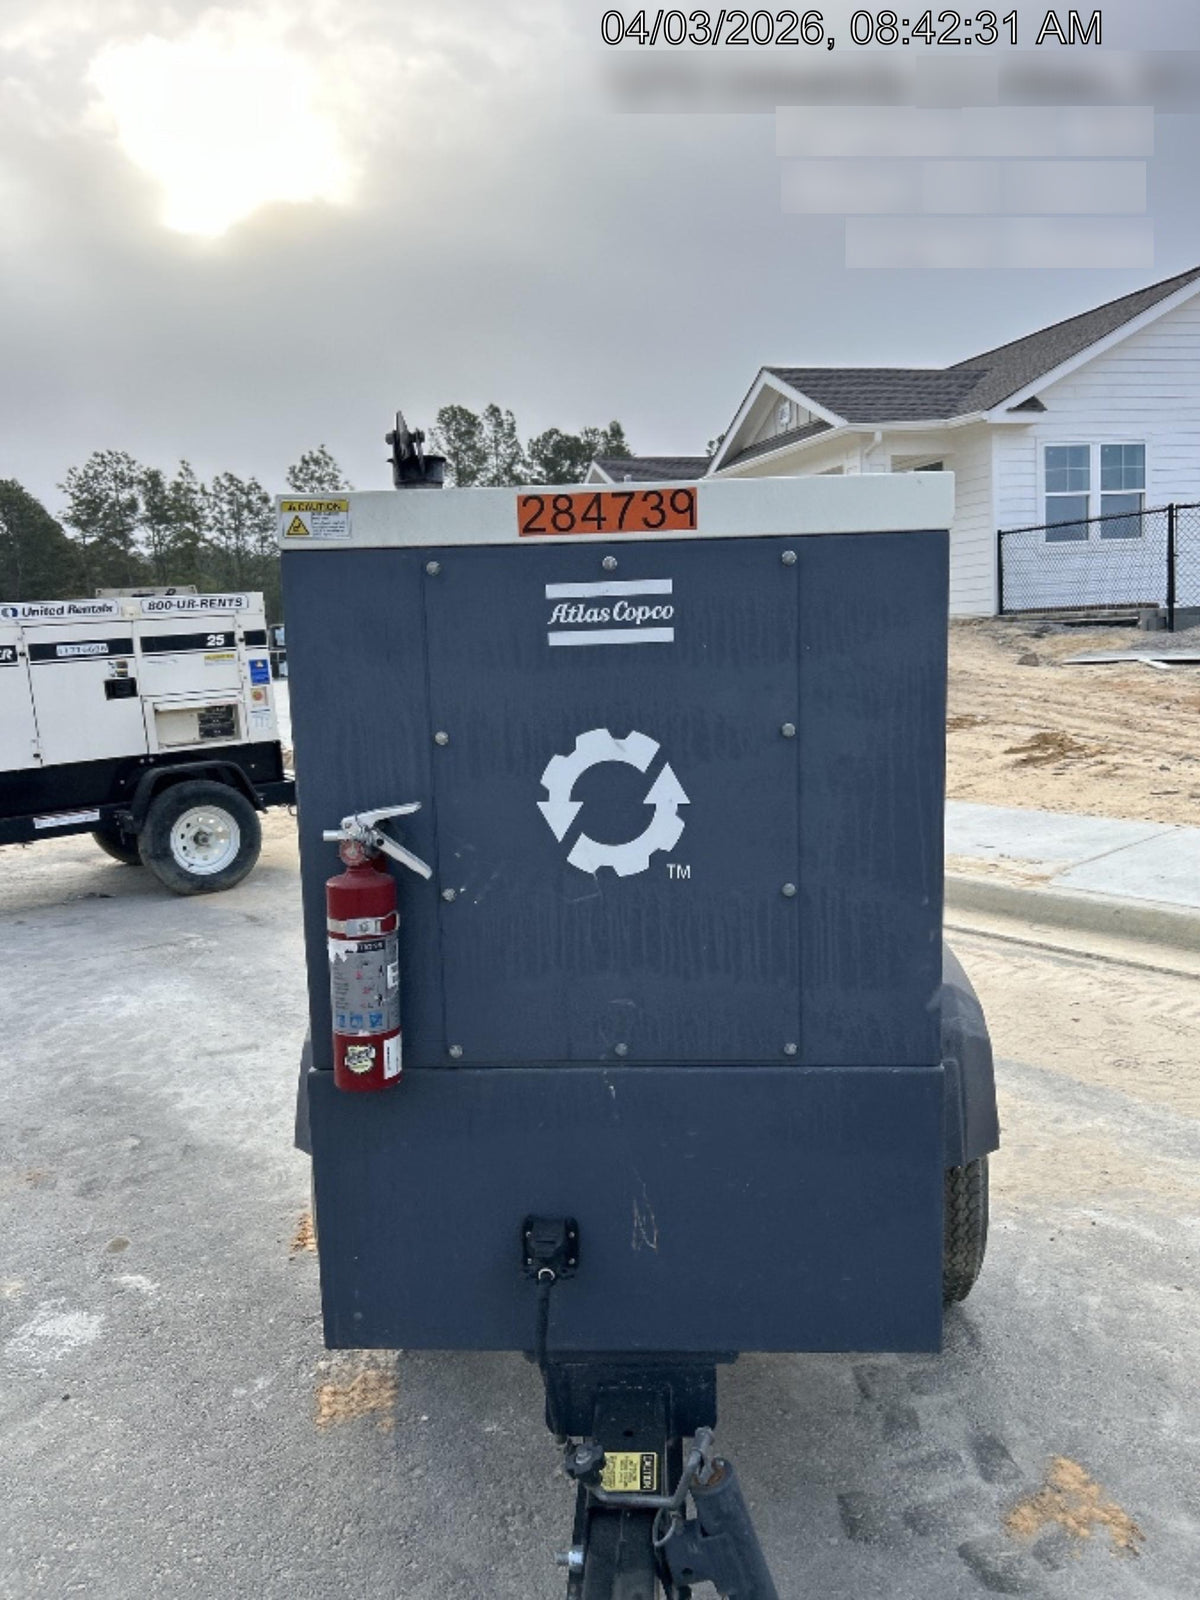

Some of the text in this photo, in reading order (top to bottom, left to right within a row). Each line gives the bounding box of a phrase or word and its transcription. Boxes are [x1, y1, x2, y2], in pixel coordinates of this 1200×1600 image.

[521, 488, 695, 534] 284739
[22, 603, 113, 617] United Rentals
[148, 597, 243, 610] 800-UR-RENTS
[547, 600, 675, 625] Atlas Copco
[206, 634, 225, 646] 25
[666, 863, 691, 879] TM
